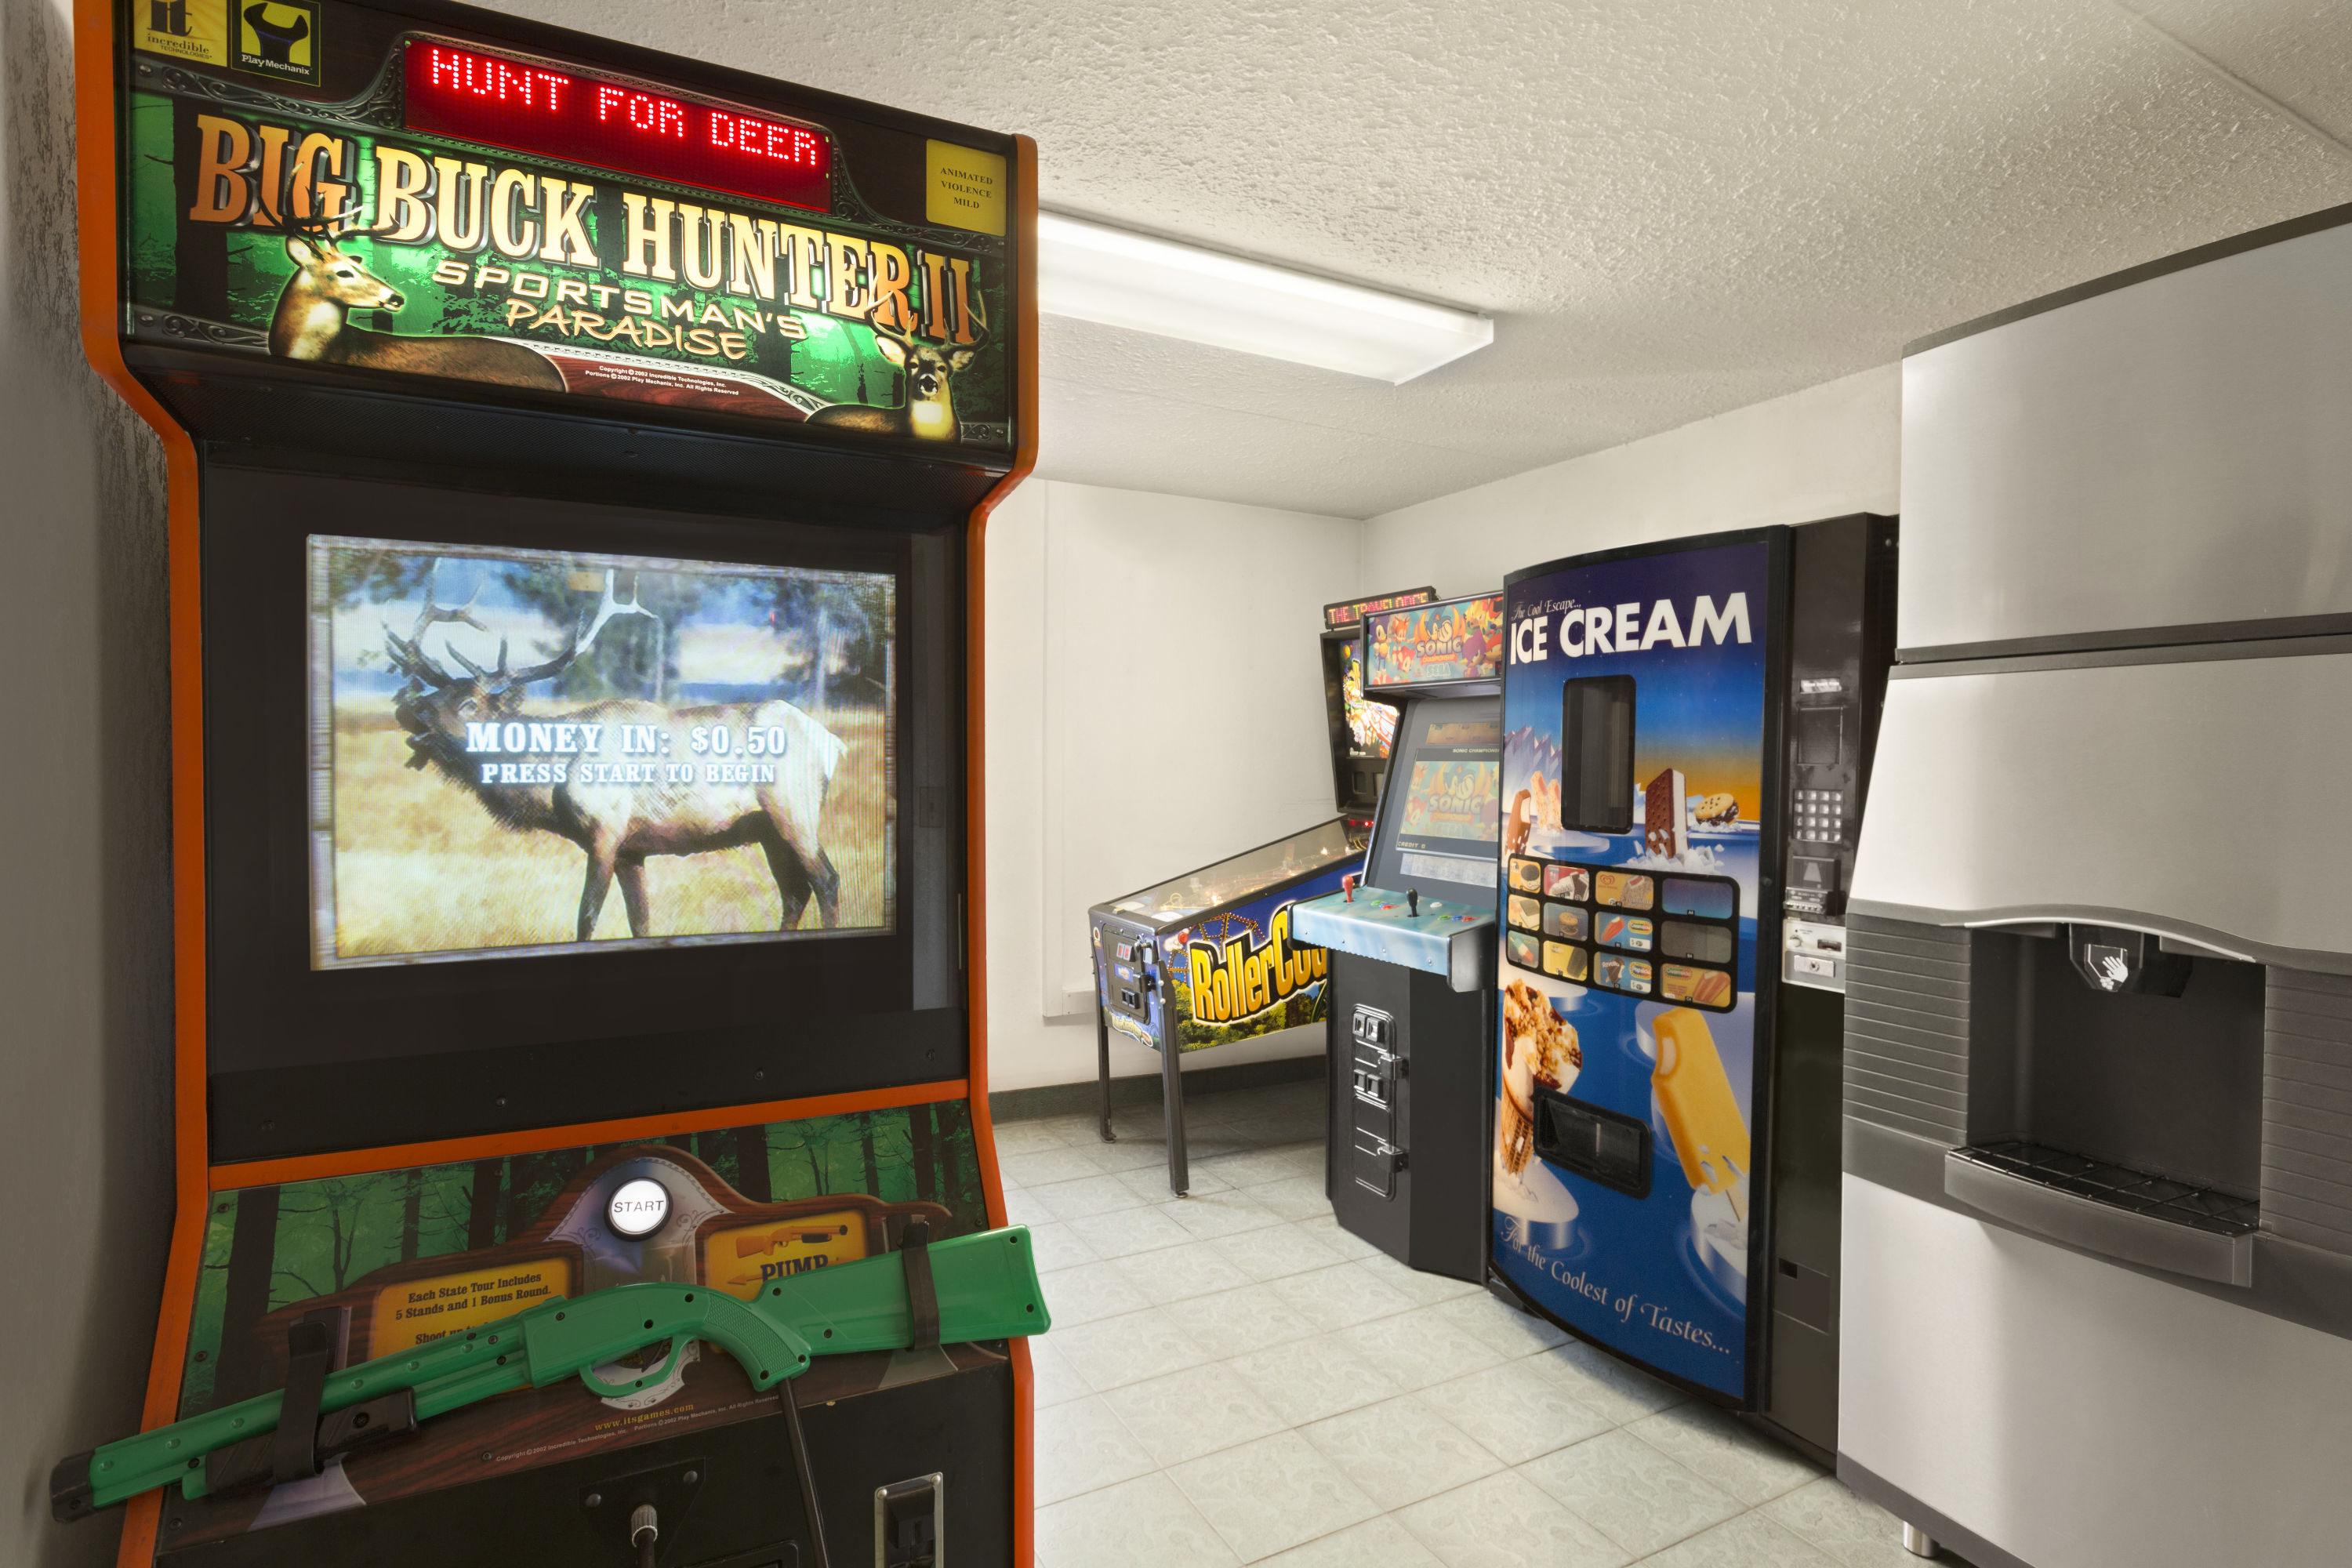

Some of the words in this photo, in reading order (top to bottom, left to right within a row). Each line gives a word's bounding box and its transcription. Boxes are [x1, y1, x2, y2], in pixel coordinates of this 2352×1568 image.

[147, 34, 209, 53] incredible
[161, 45, 211, 60] TECHNOLOGIES
[432, 49, 570, 111] HUNT
[600, 87, 684, 137] FOR
[710, 112, 816, 166] DEER
[941, 167, 993, 185] ANIMATED
[942, 180, 992, 198] VIOLENCE
[954, 197, 979, 209] MILD
[189, 114, 347, 234] BIG
[372, 146, 599, 266] BUCK
[622, 191, 918, 334] HUNTER
[922, 250, 975, 345] II
[432, 260, 808, 340] SPORTSMAN'S
[506, 298, 747, 360] PARADISE
[599, 365, 627, 375] Copyright
[649, 372, 677, 381] Incredible
[678, 376, 715, 387] Technologies,
[645, 378, 673, 387] Mechanix,
[1329, 606, 1350, 624] THE
[1512, 601, 1526, 621] The
[1528, 600, 1543, 617] Cool
[1510, 615, 1548, 665] ICE
[1559, 592, 1752, 658] CREAM
[1417, 636, 1462, 659] SONIC
[466, 722, 602, 753] MONEY
[621, 724, 670, 754] IN:
[691, 724, 786, 756] $0.50
[481, 763, 568, 784] PRESS
[580, 763, 656, 783] START
[666, 764, 693, 783] TO
[706, 764, 775, 783] BEGIN
[1428, 794, 1483, 815] SONIC
[614, 1200, 664, 1214] START
[408, 1290, 436, 1303] Each
[439, 1285, 467, 1299] State
[470, 1281, 495, 1293] Tour
[497, 1273, 542, 1288] Includes
[1501, 1216, 1524, 1254] For
[1527, 1244, 1546, 1271] the
[1551, 1260, 1609, 1305] Coolest
[1614, 1294, 1638, 1323] of
[1640, 1302, 1730, 1355] Tastes...
[396, 1310, 402, 1320] 5
[405, 1303, 444, 1319] Stands
[448, 1299, 468, 1312] and
[472, 1297, 477, 1307] 1
[481, 1293, 513, 1305] Bonus
[516, 1285, 552, 1300] Round.
[416, 1330, 446, 1345] Shoot
[594, 1403, 695, 1432] www.itsgames.com
[496, 1452, 526, 1461] Copyright
[548, 1440, 576, 1450] Incredible
[578, 1432, 616, 1443] Technologies,
[634, 1422, 657, 1431] Portions
